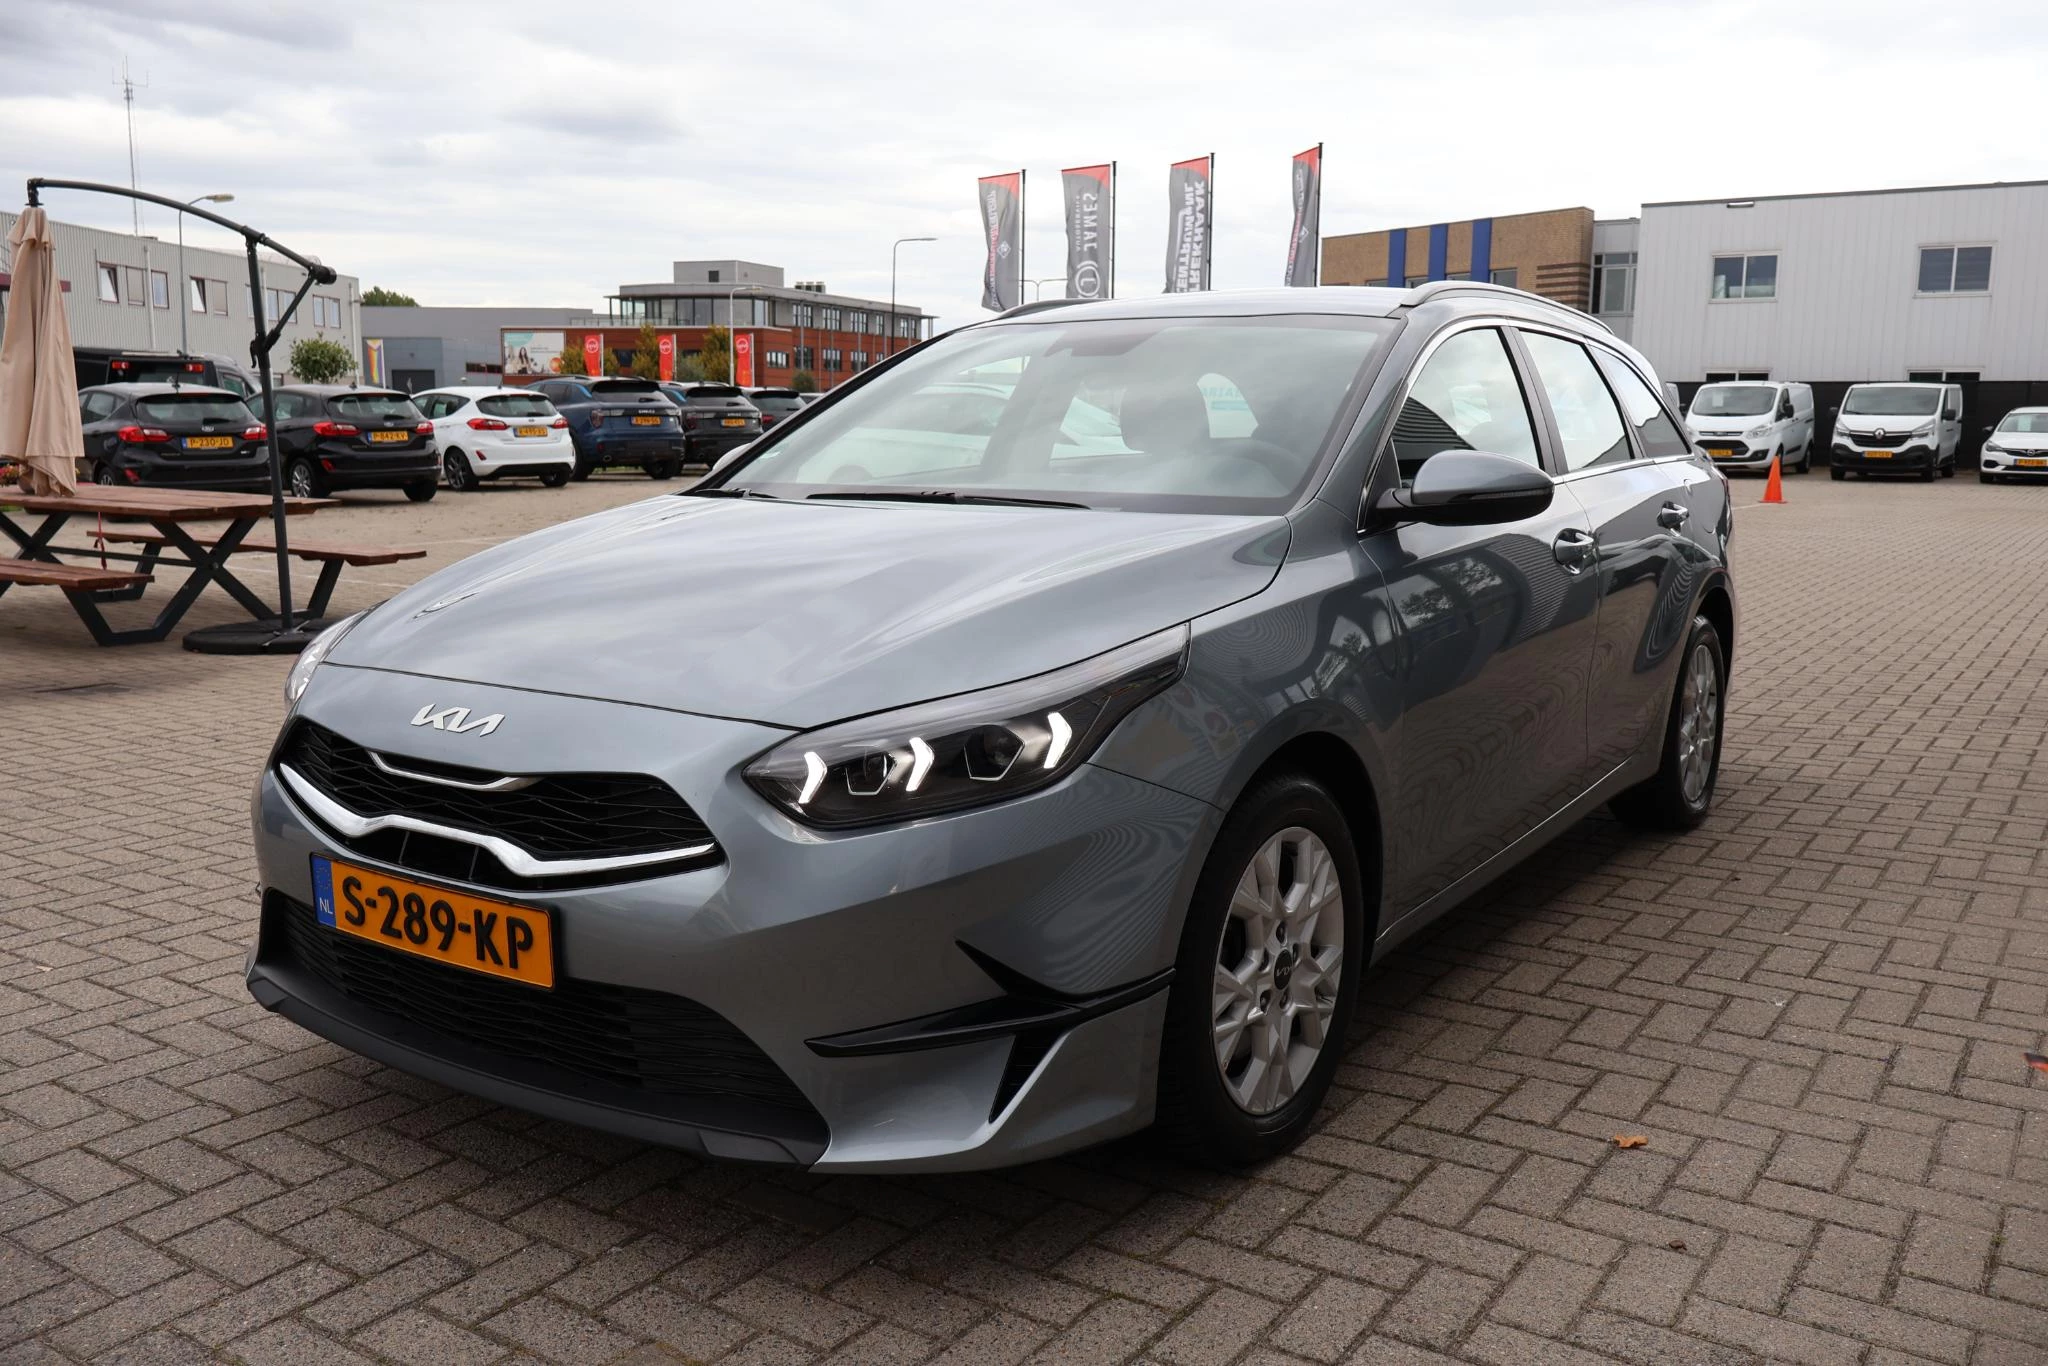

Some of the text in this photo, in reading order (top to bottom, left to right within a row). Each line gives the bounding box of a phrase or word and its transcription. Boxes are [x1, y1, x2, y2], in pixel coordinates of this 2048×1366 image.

[410, 703, 505, 737] KIA
[319, 896, 334, 915] NL
[342, 876, 533, 969] S-289-KP
